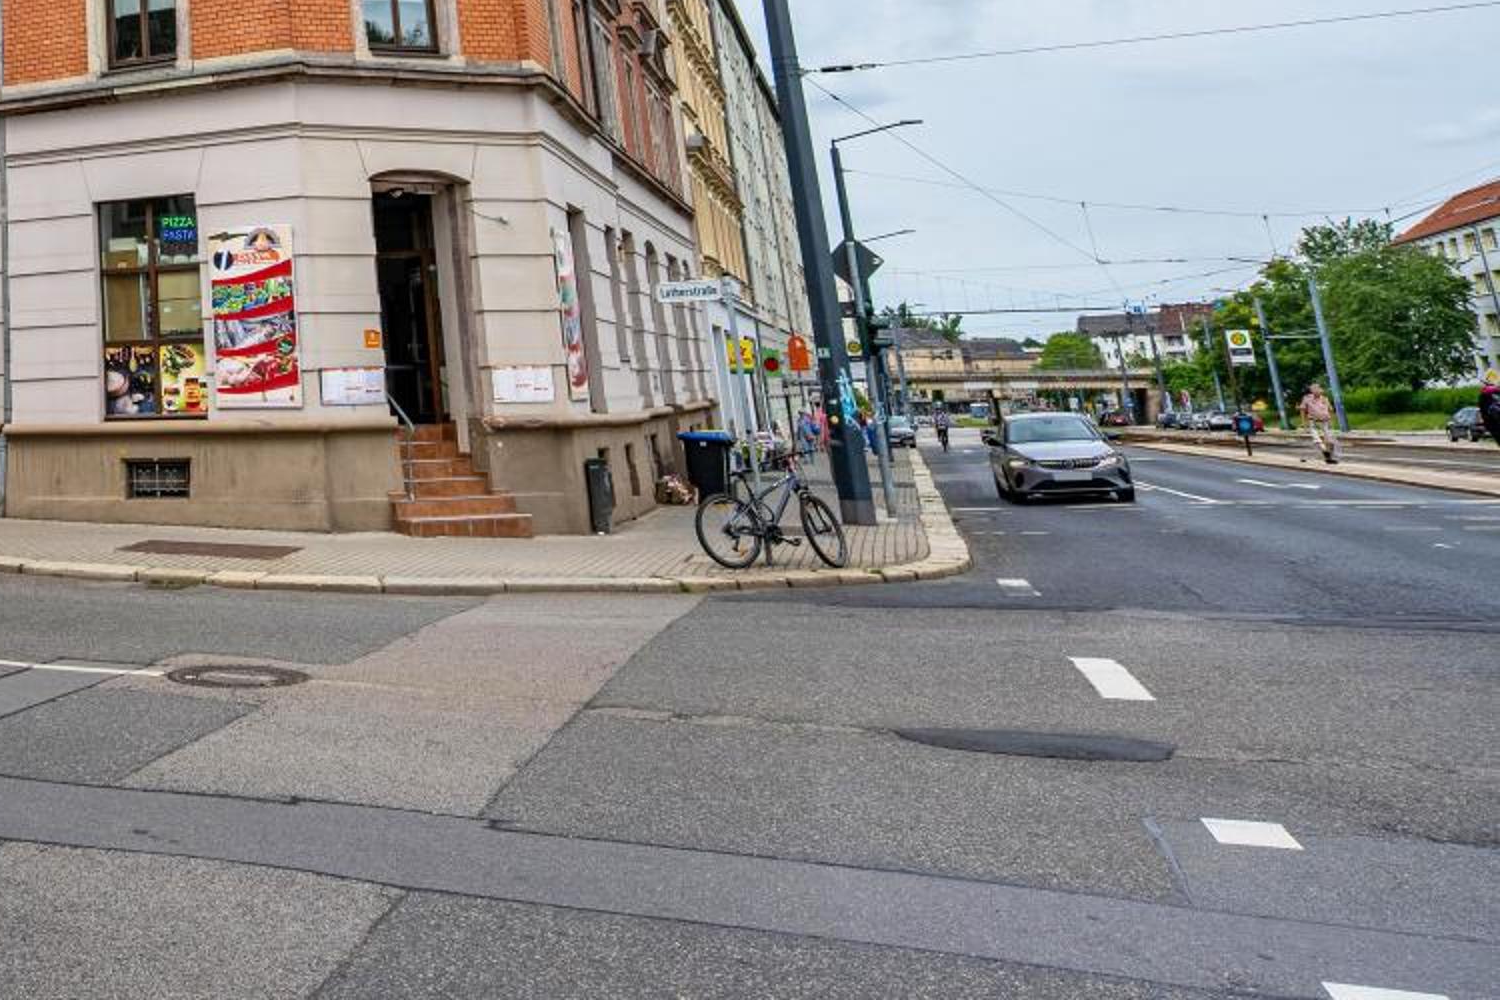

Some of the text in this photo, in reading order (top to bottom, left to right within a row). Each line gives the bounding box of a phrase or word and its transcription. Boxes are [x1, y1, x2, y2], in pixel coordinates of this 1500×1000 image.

[163, 217, 195, 227] PIZZA
[163, 230, 196, 240] PASTA
[660, 286, 717, 298] Lutherstraße
